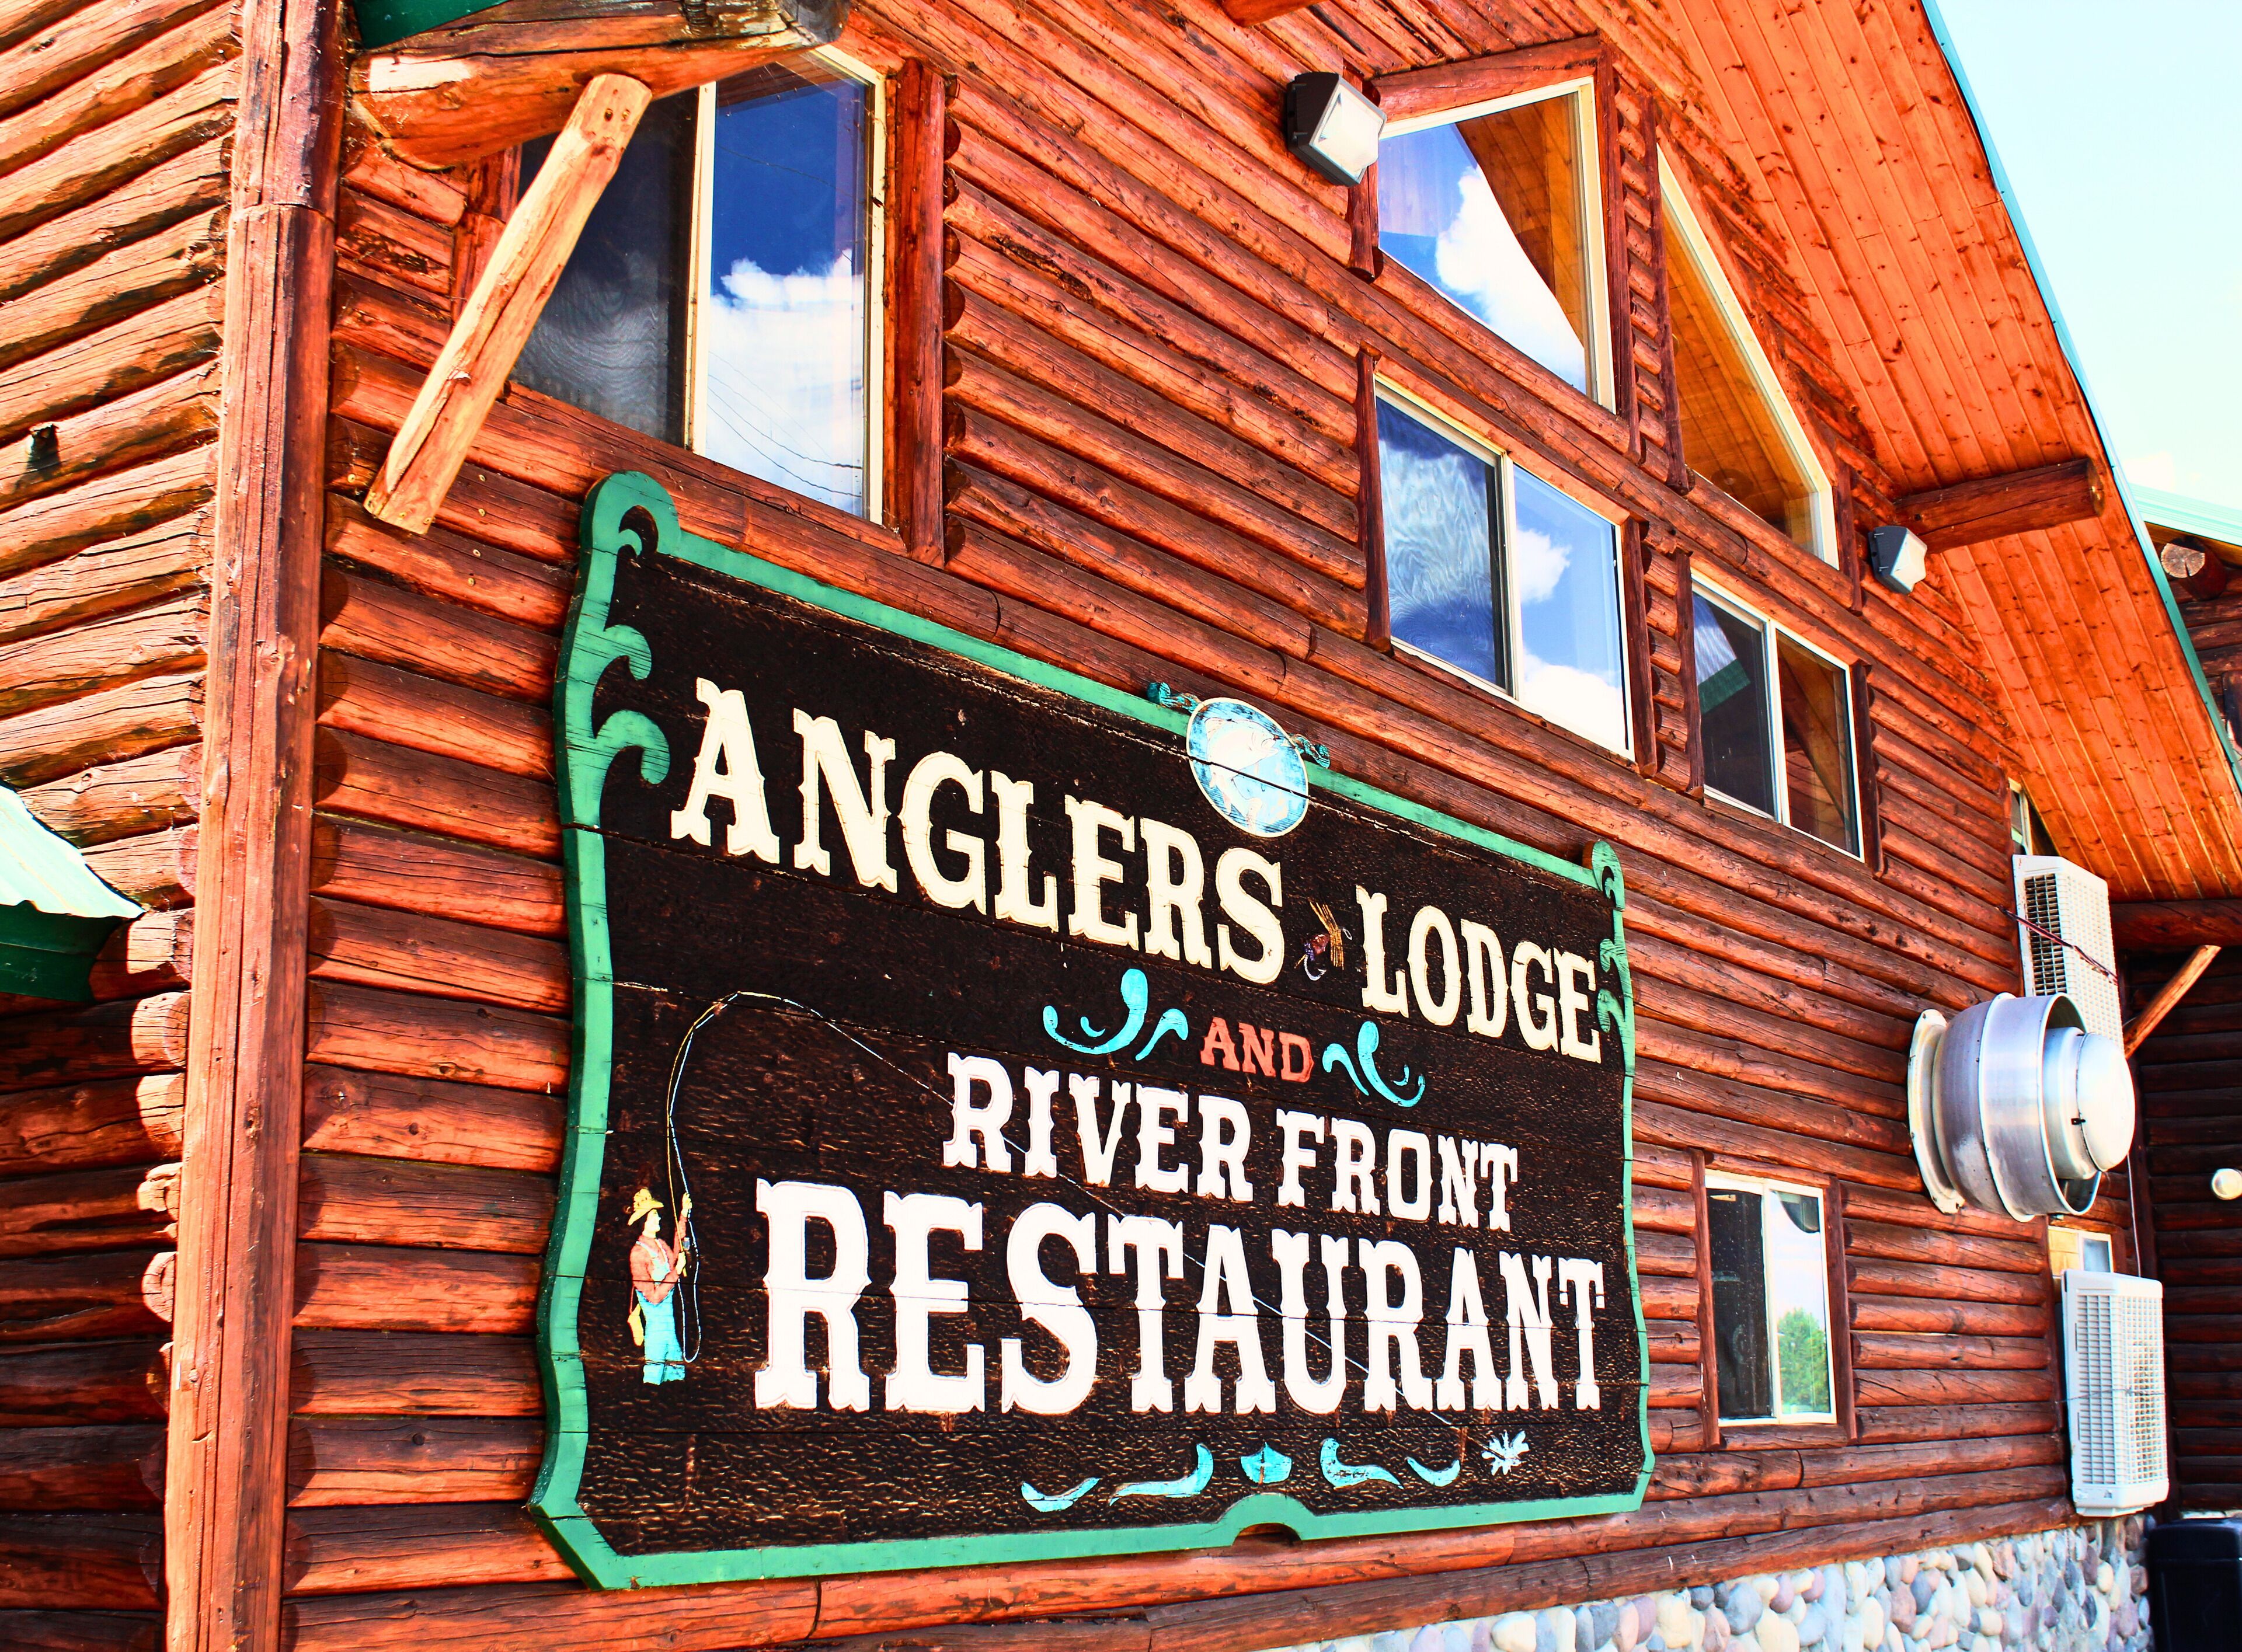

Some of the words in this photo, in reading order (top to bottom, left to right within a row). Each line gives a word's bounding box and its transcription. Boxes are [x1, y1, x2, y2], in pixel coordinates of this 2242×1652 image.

[671, 678, 1284, 984] ANGLERS
[1356, 885, 1601, 1063] LODGE
[943, 1052, 1253, 1202] RIVER
[1276, 1109, 1518, 1232] FRONT
[1200, 1017, 1315, 1082] AND
[754, 1178, 1605, 1414] RESTAURANT
